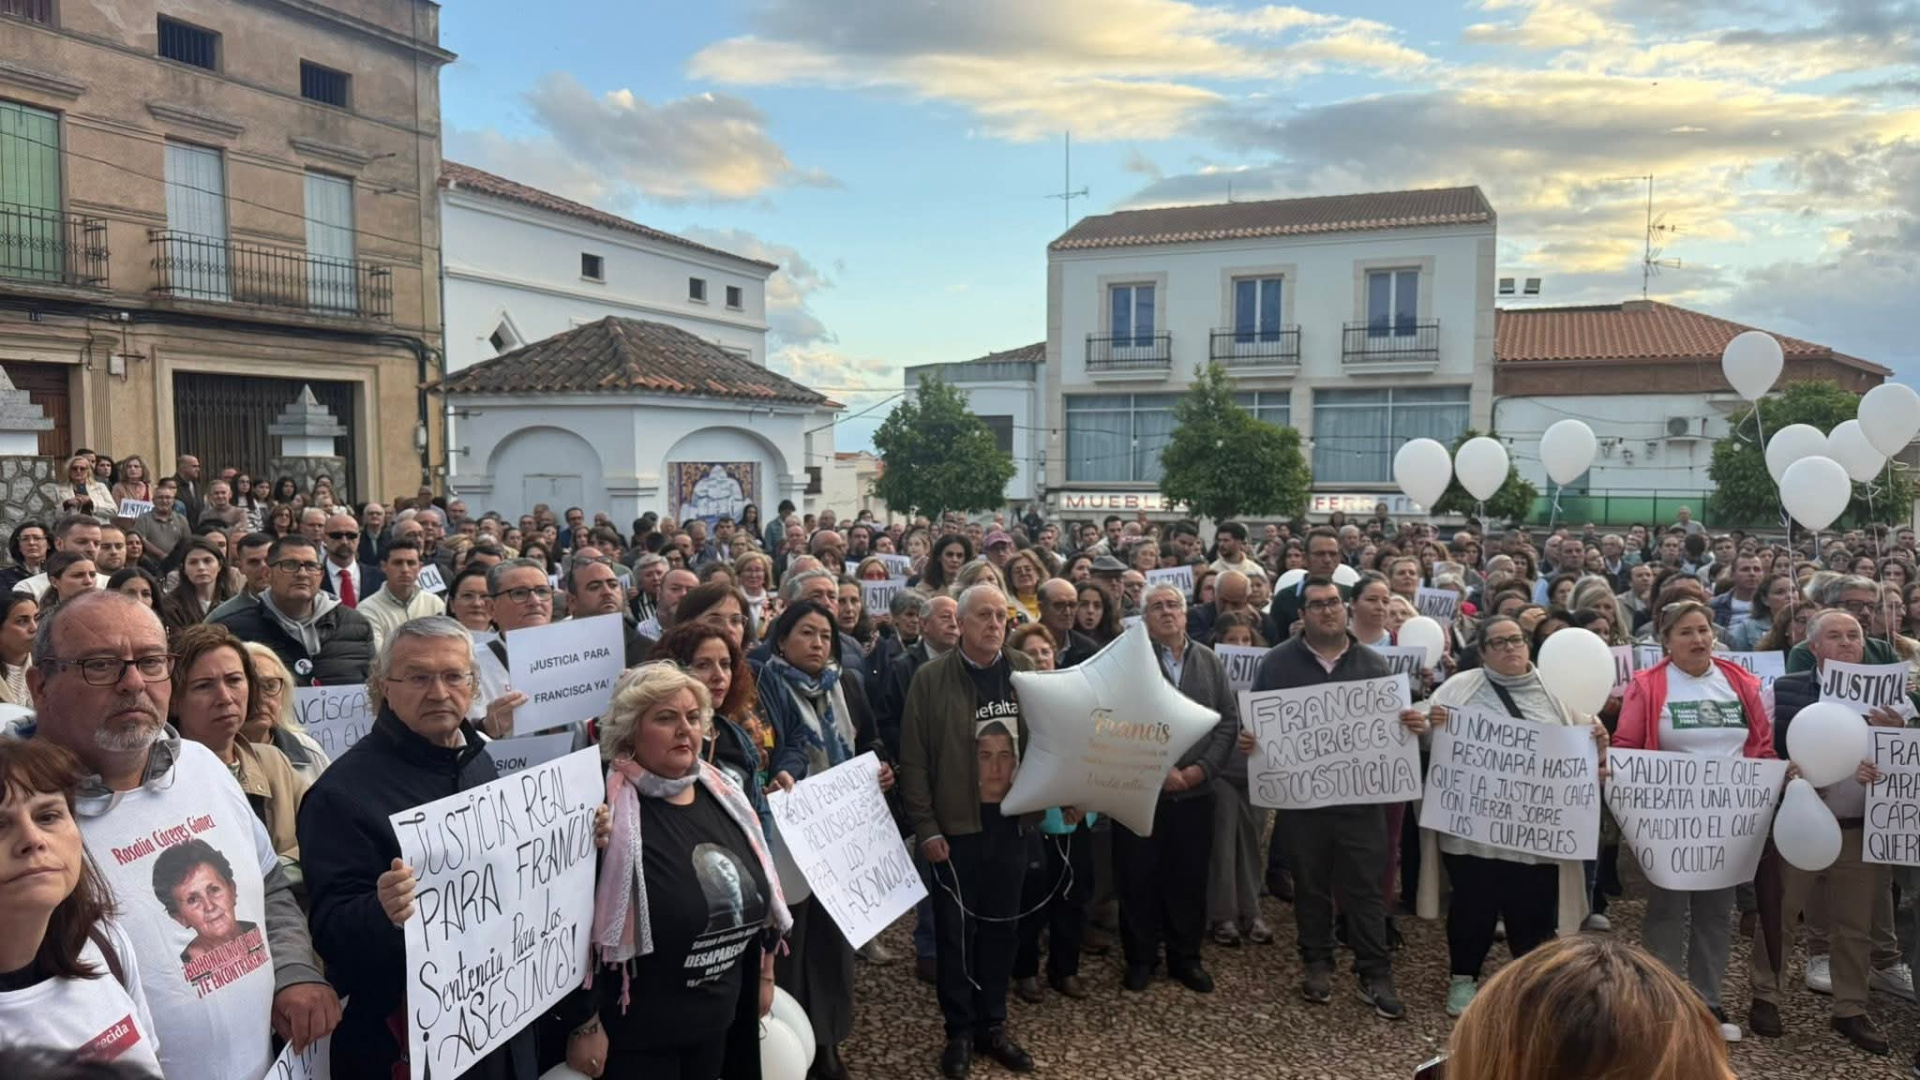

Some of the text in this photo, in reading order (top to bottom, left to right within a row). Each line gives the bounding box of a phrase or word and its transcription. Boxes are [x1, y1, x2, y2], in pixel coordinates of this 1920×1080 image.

[530, 647, 610, 673] ¡JUSTICIA PARA
[1383, 655, 1421, 680] TICIA
[535, 679, 610, 703] FRANCISCA YA!
[1823, 669, 1905, 706] JUSTICIA
[1090, 708, 1171, 745] Francis
[1251, 681, 1403, 739] FRANCIS
[1439, 704, 1540, 751] TU NOMBRE
[1266, 718, 1390, 770] MERECE
[1452, 741, 1588, 779] RESONARÁ HASTA
[494, 757, 527, 771] SION
[1256, 754, 1416, 803] JUSTICIA
[1609, 754, 1763, 786] MALDITO EL QUE
[1430, 764, 1596, 810] QUE LA JUSTICIA CAIGA
[1609, 785, 1695, 811] ARREBATA
[1701, 787, 1732, 809] UNA
[398, 766, 576, 882] JUSTICIA REAL
[1440, 790, 1563, 826] CON FUERZA SOBRE
[1636, 816, 1701, 840] MALDITO
[1708, 815, 1725, 839] EL
[1731, 813, 1760, 837] QUE
[152, 824, 191, 848] Cáceres
[186, 814, 217, 835] Gómez
[1449, 813, 1578, 854] LOS CULPABLES
[414, 802, 595, 952] PARA FRANCIS
[1671, 845, 1725, 874] OCULTA
[416, 887, 562, 1030] Sentencia Para Los
